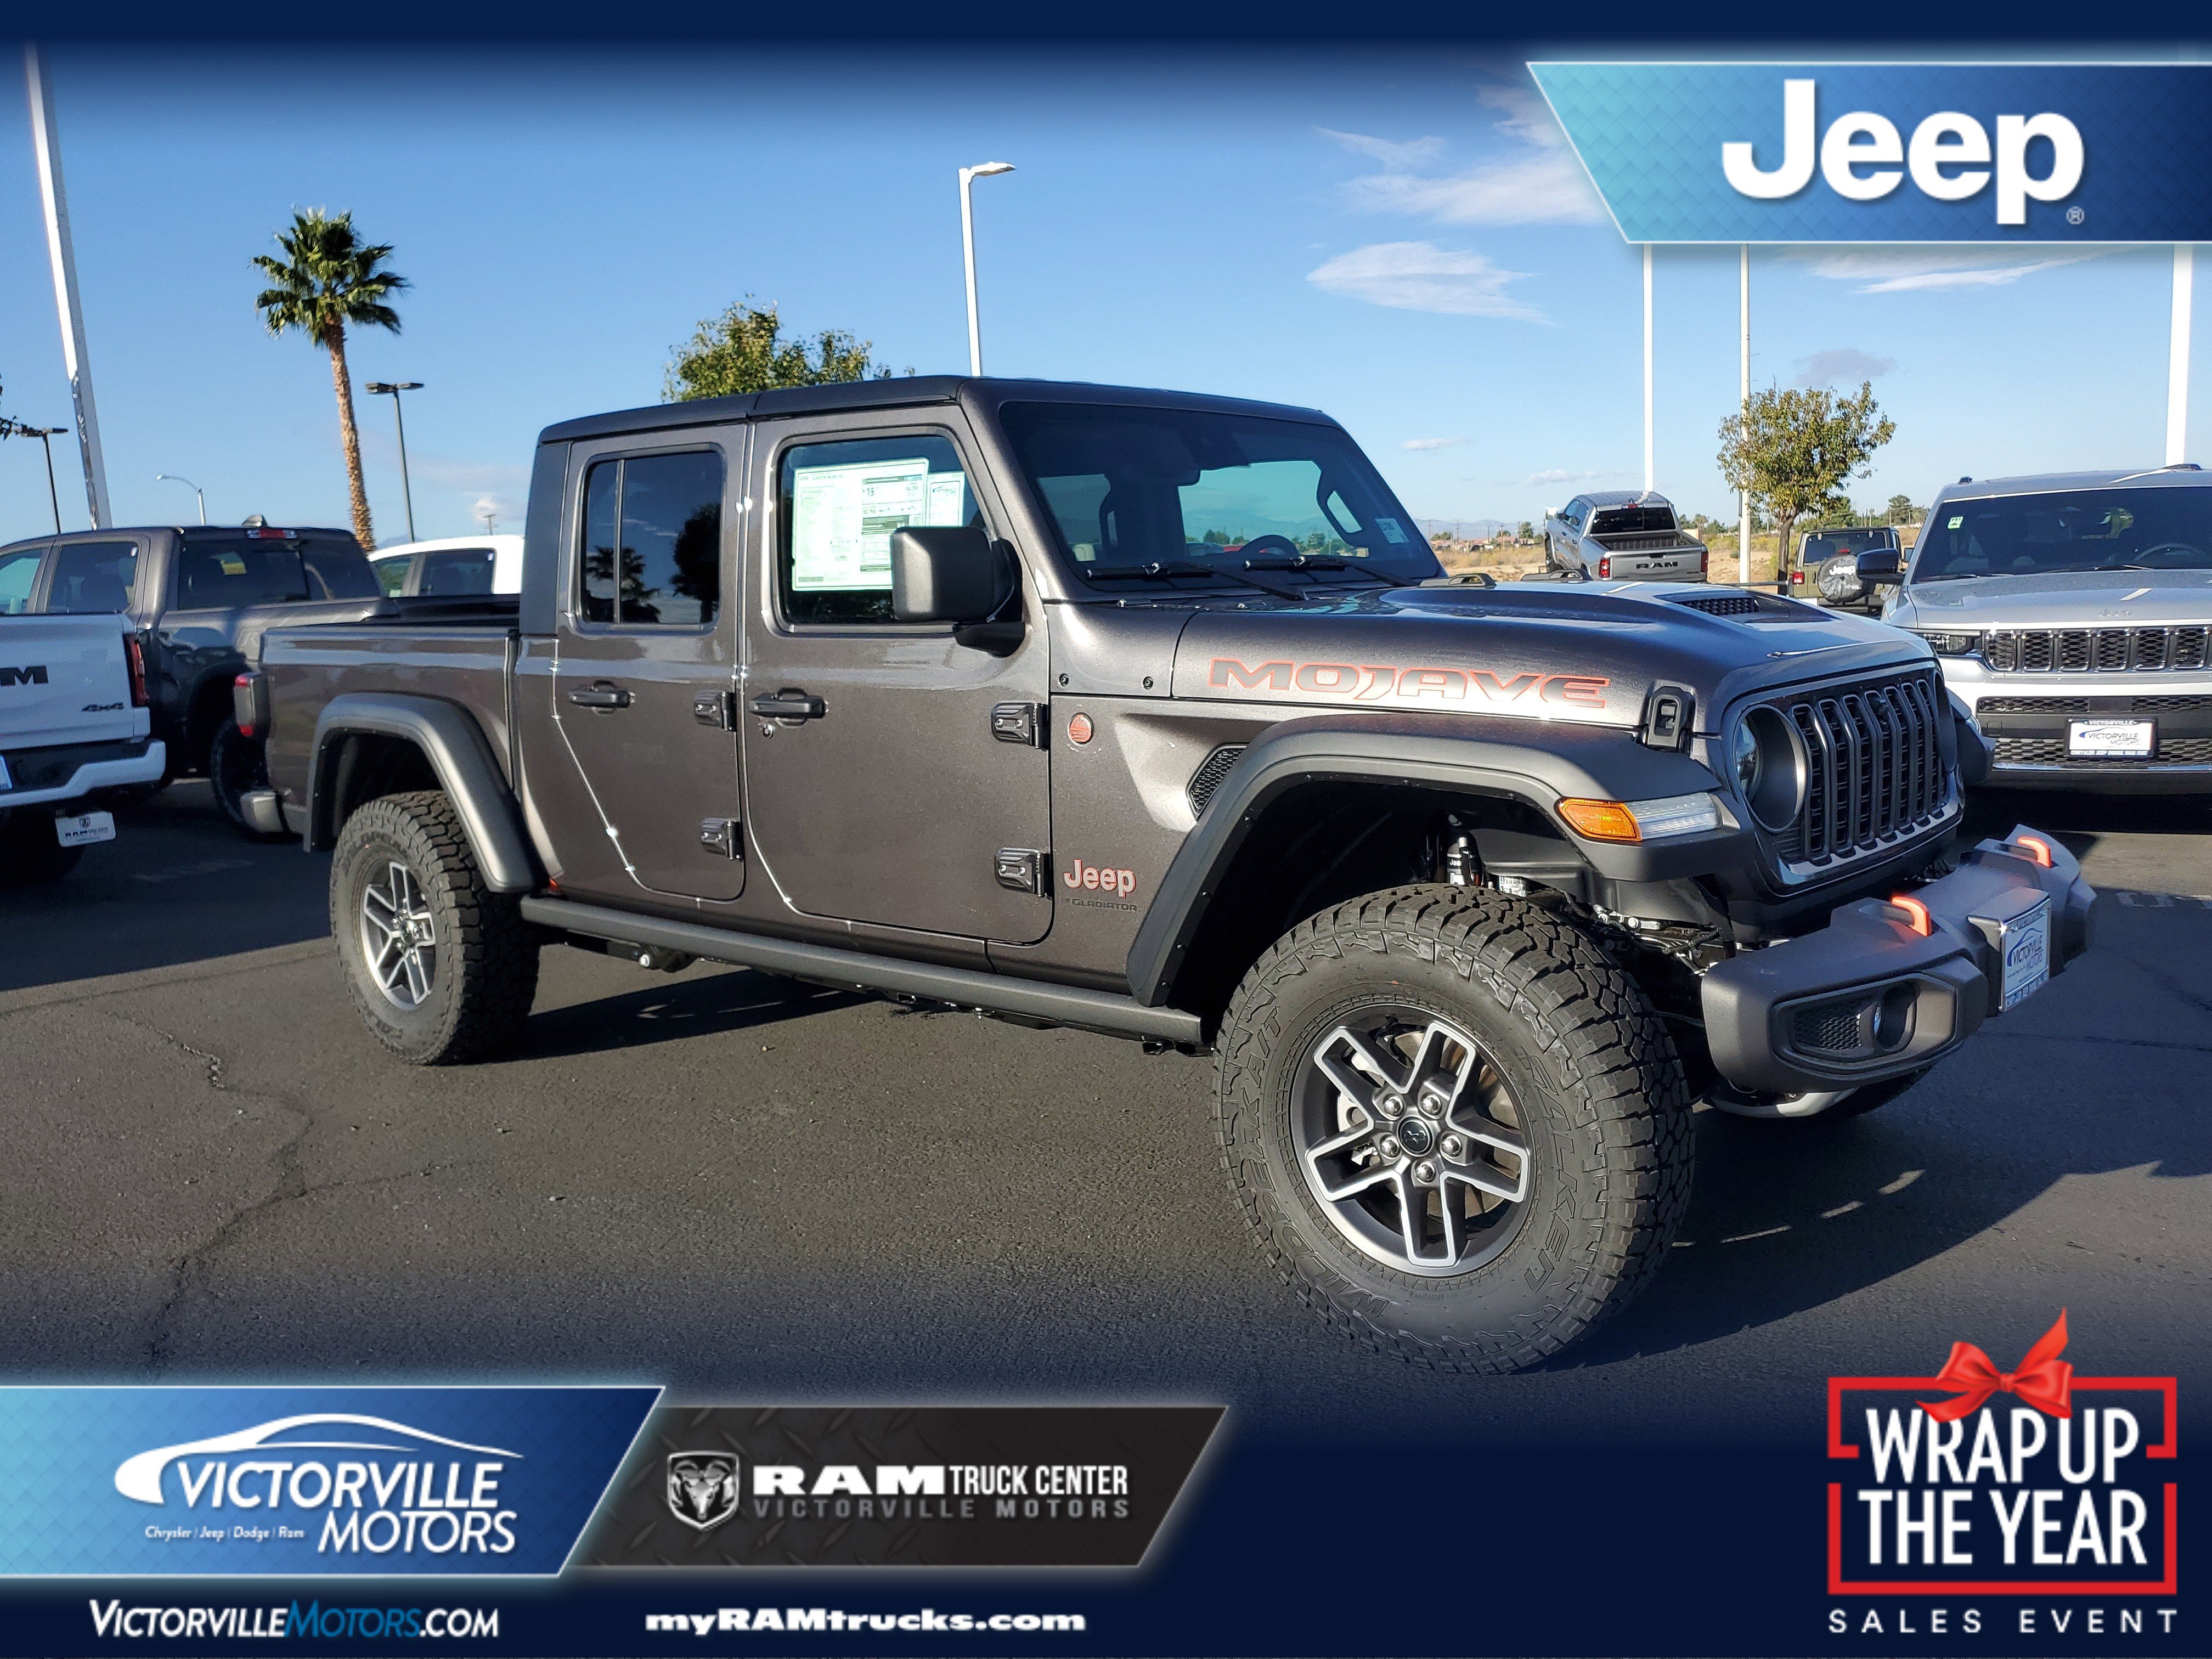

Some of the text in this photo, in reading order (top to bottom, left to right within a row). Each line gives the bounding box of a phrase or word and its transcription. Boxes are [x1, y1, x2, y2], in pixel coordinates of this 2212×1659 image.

[1829, 565, 1855, 575] Jeep
[1209, 658, 1610, 709] MOJAVE
[1063, 859, 1137, 899] Jeep
[1071, 898, 1137, 912] GLADIATOR
[1519, 1044, 1578, 1293] FALKEN
